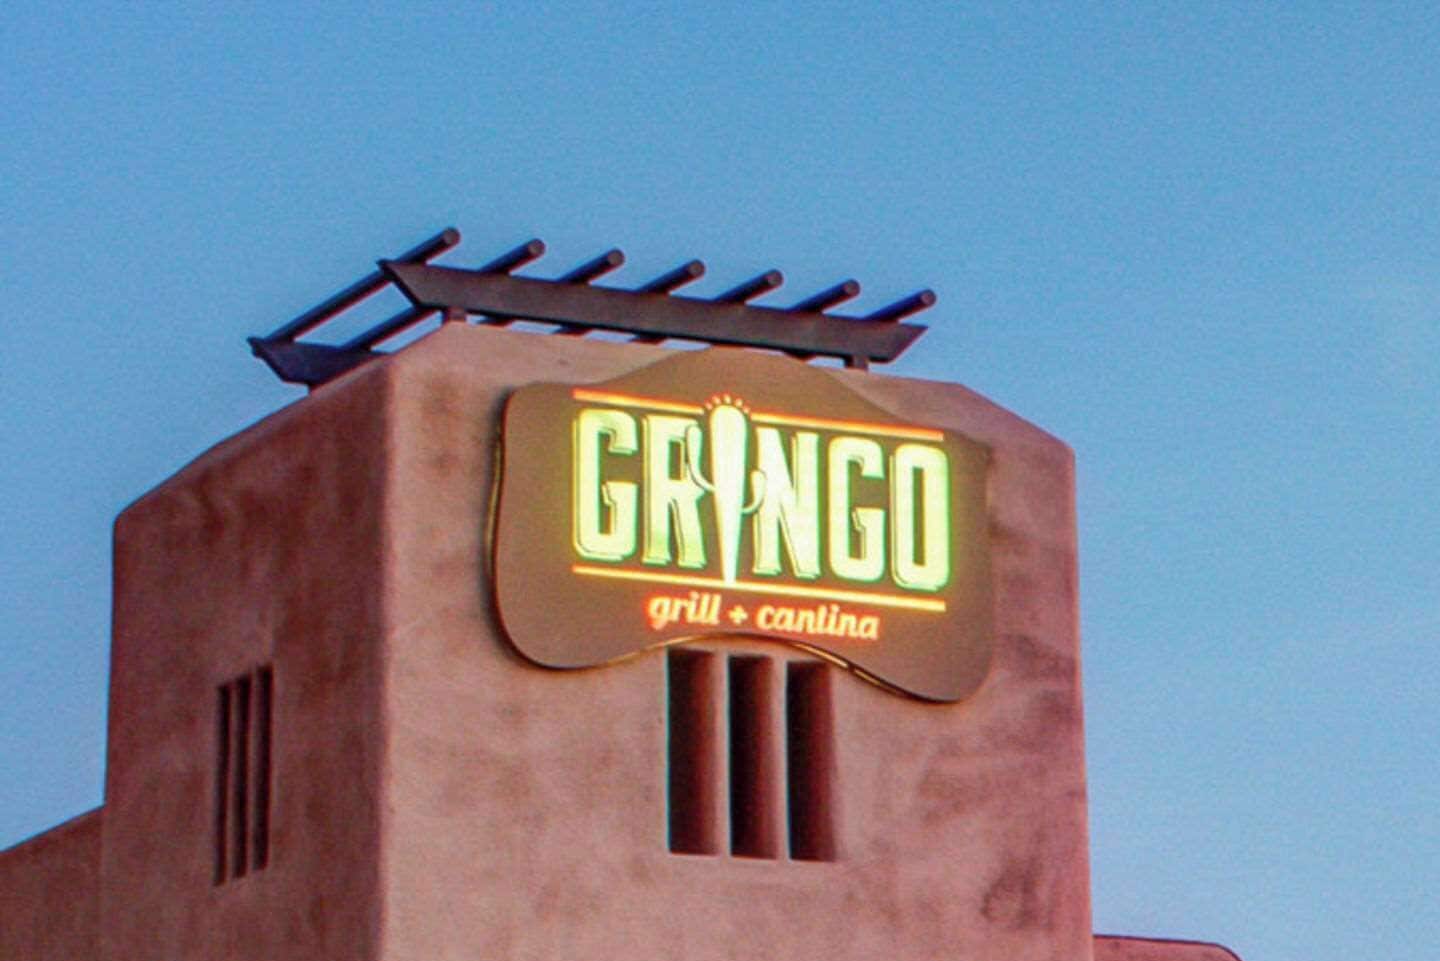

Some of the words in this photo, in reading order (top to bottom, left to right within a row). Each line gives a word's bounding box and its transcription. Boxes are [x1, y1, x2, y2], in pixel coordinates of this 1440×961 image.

[573, 403, 950, 591] GRINGO
[649, 592, 721, 630] grill
[757, 604, 880, 640] cantina
